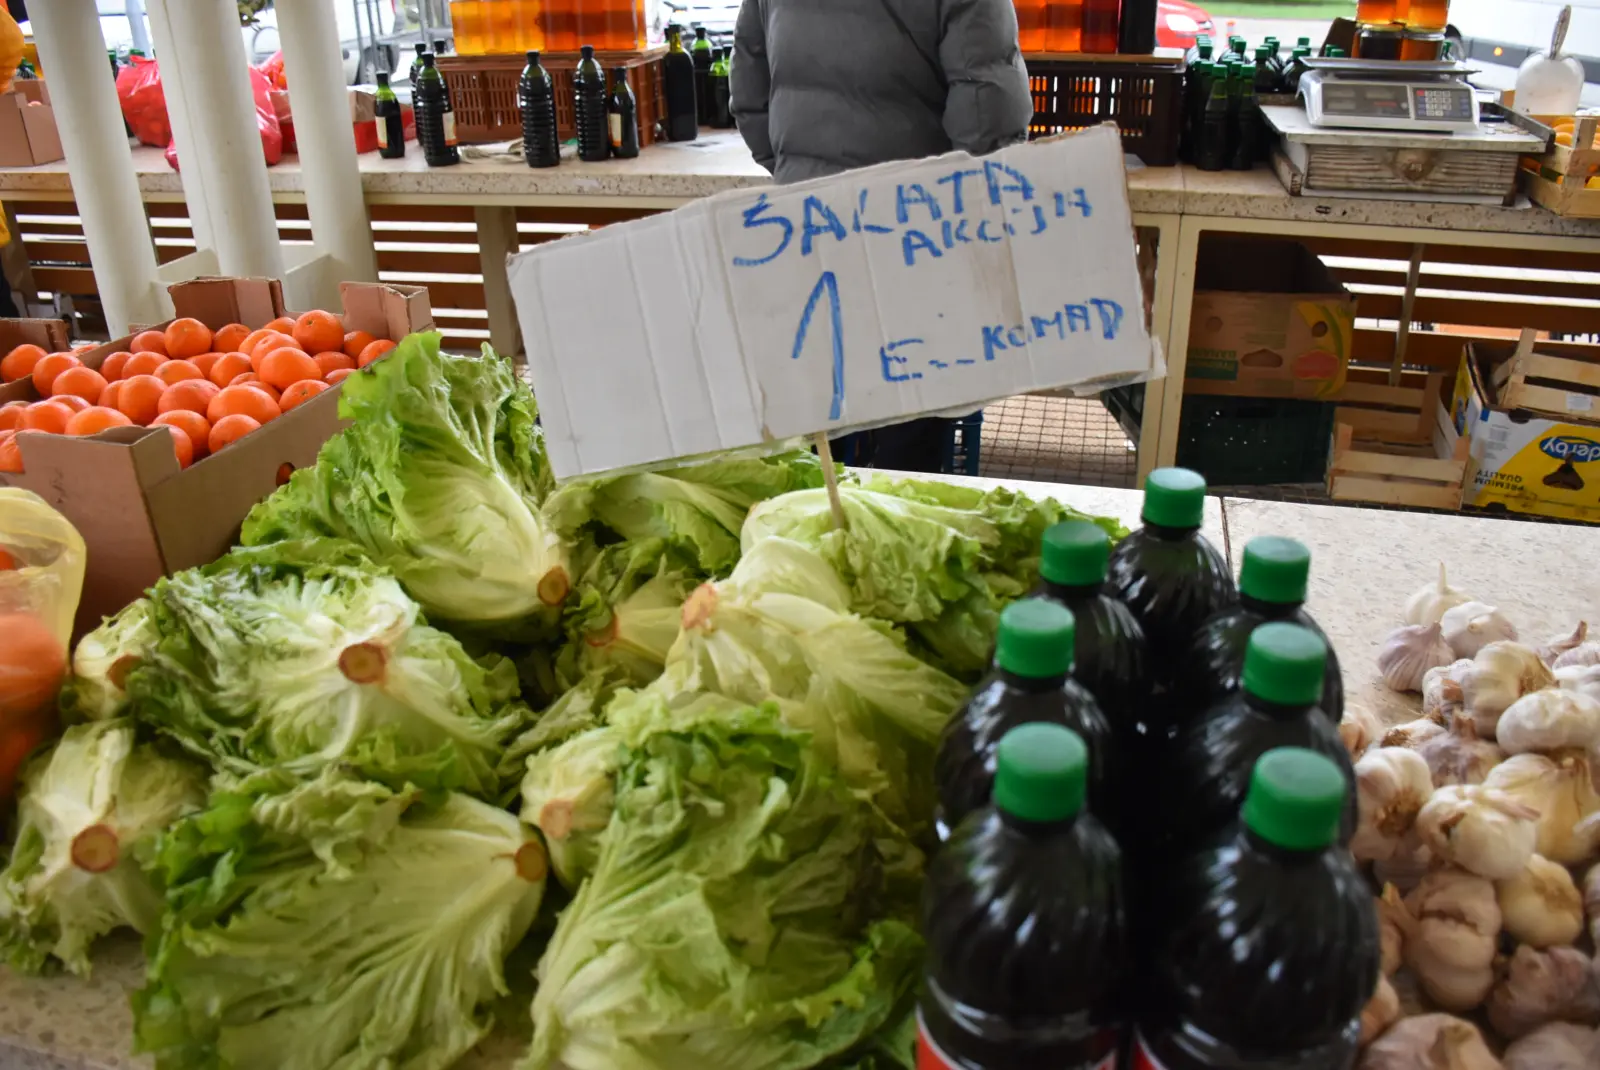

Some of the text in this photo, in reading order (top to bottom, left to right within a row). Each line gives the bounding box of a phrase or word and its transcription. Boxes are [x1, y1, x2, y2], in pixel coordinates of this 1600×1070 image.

[902, 188, 1093, 266] AKCIJA
[791, 271, 845, 421] 1
[981, 298, 1124, 362] KOMAD
[1542, 437, 1600, 462] derby
